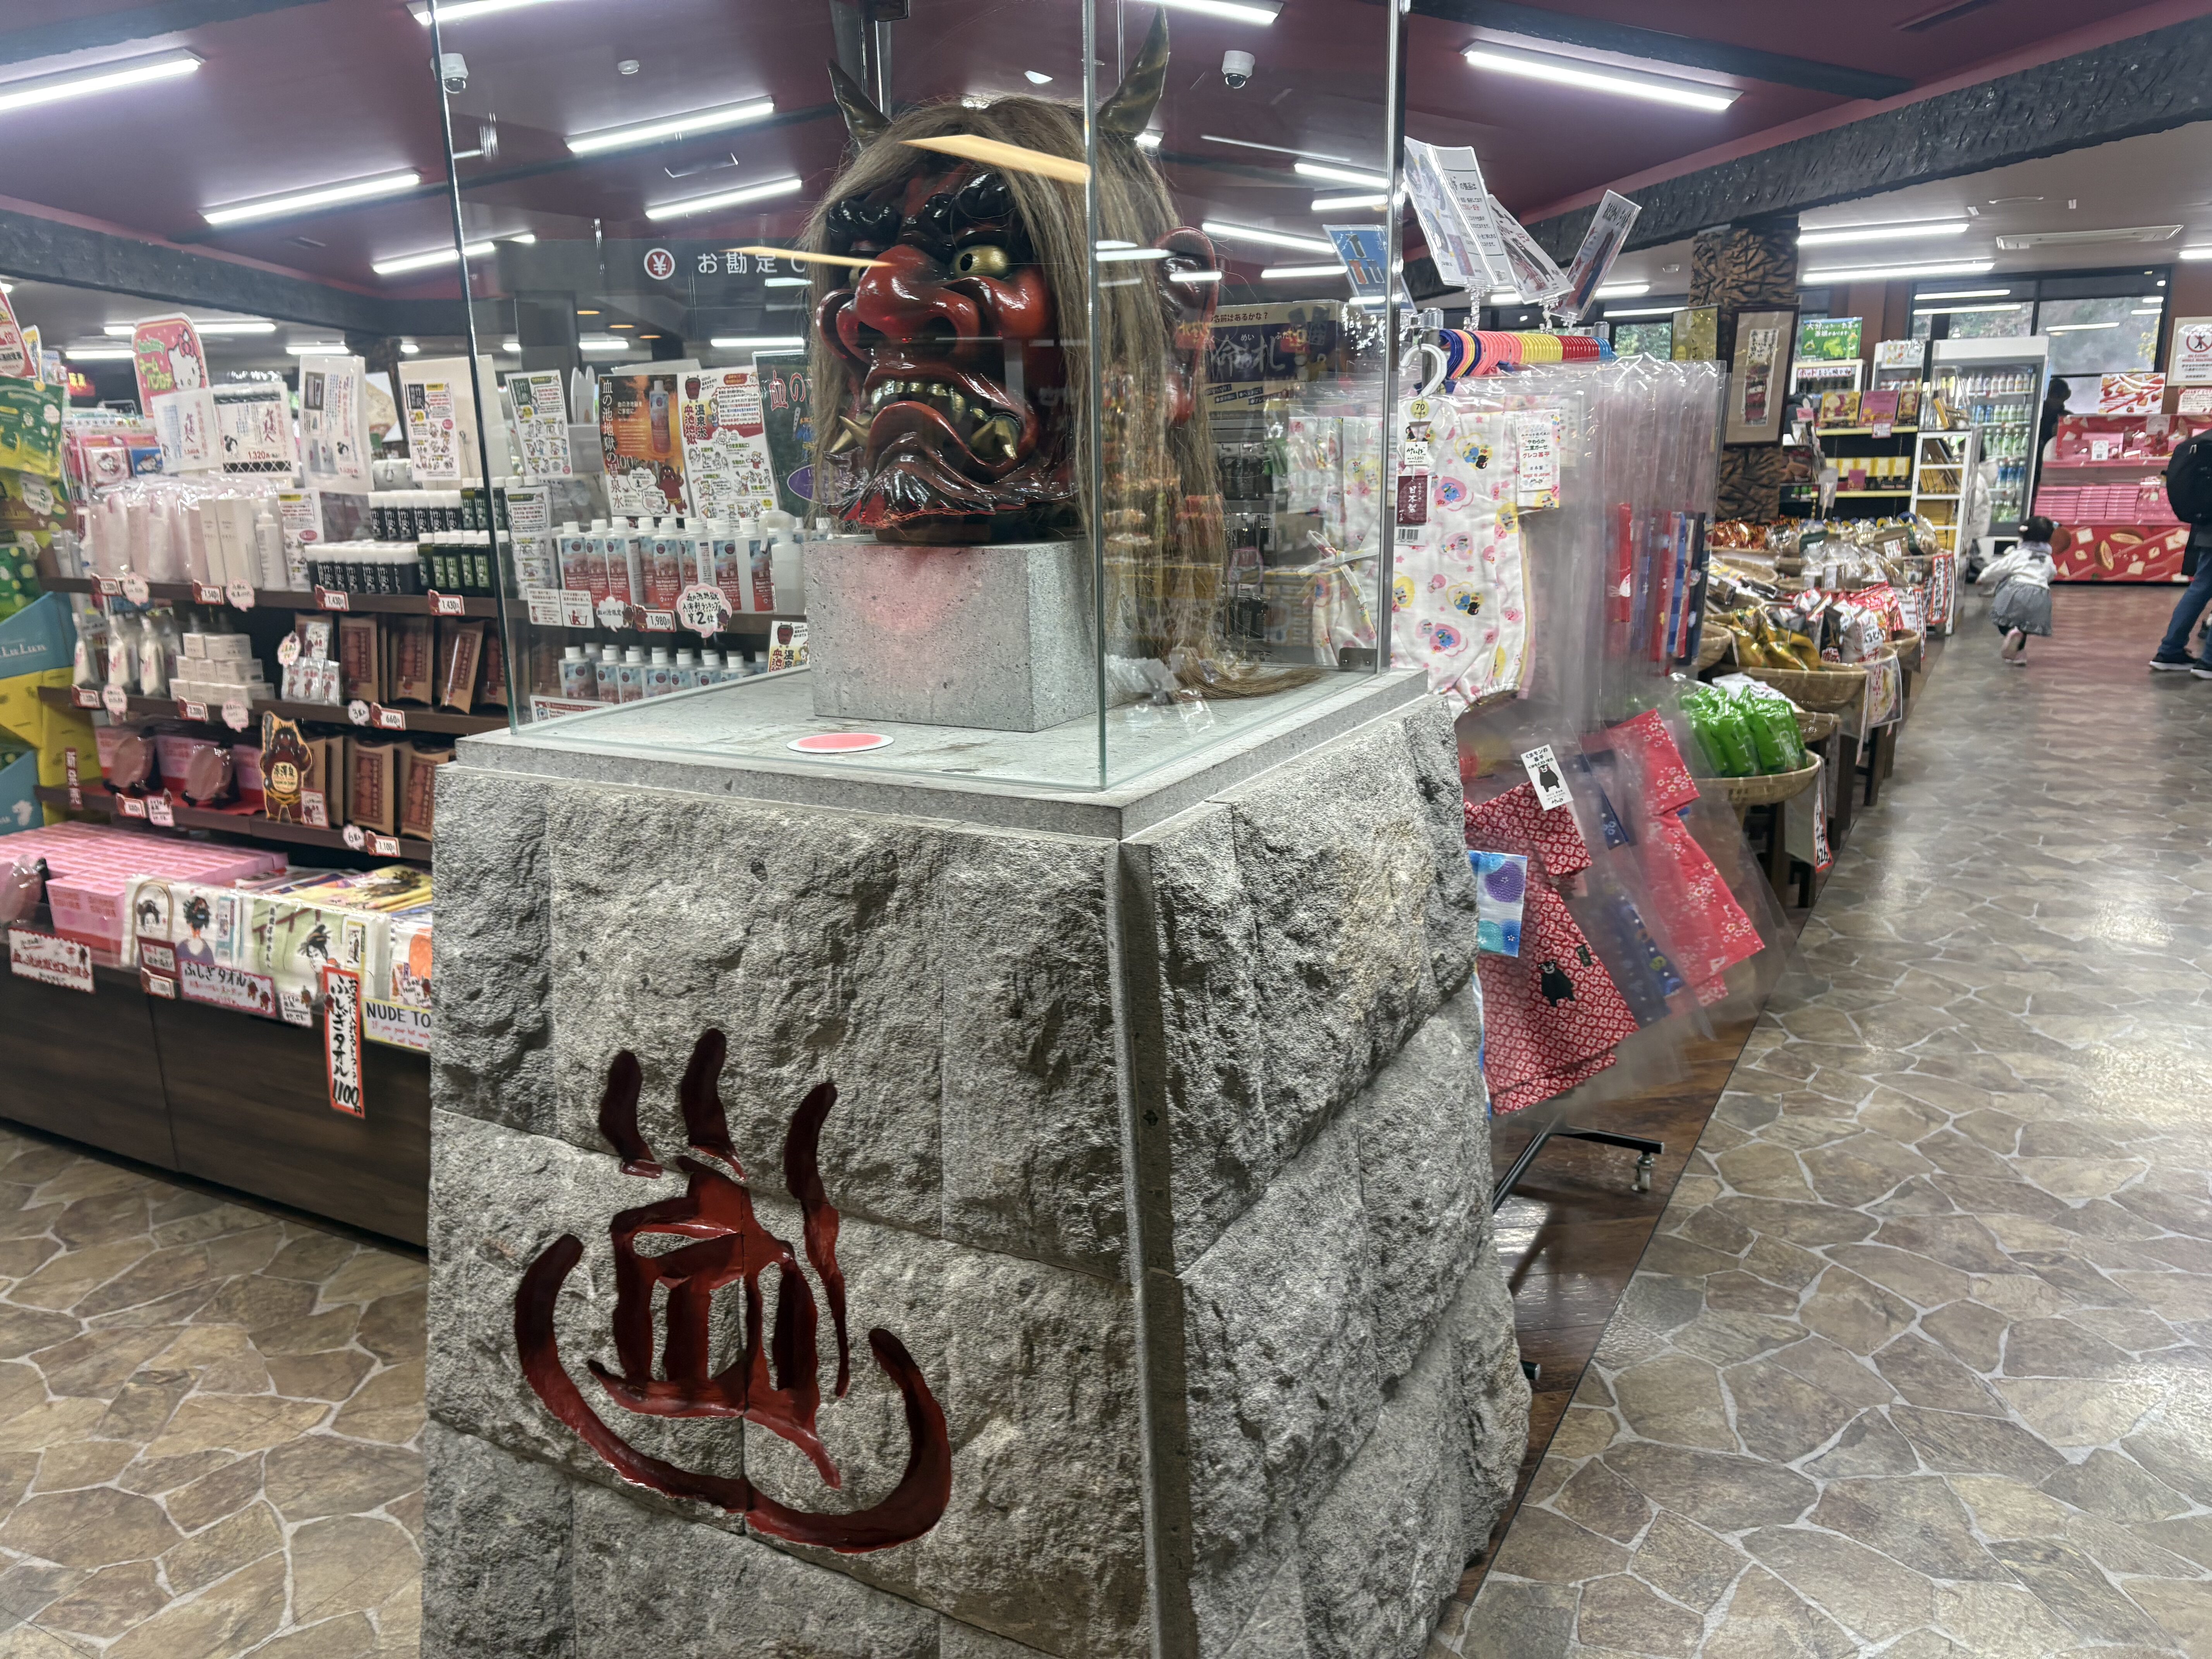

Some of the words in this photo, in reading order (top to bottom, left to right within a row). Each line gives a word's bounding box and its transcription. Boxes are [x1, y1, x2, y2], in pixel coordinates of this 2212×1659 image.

[696, 404, 708, 438] 温泉水
[602, 379, 624, 508] 血の池地獄の温泉水
[687, 592, 720, 601] 血の池地獄
[366, 1002, 406, 1023] NUDE
